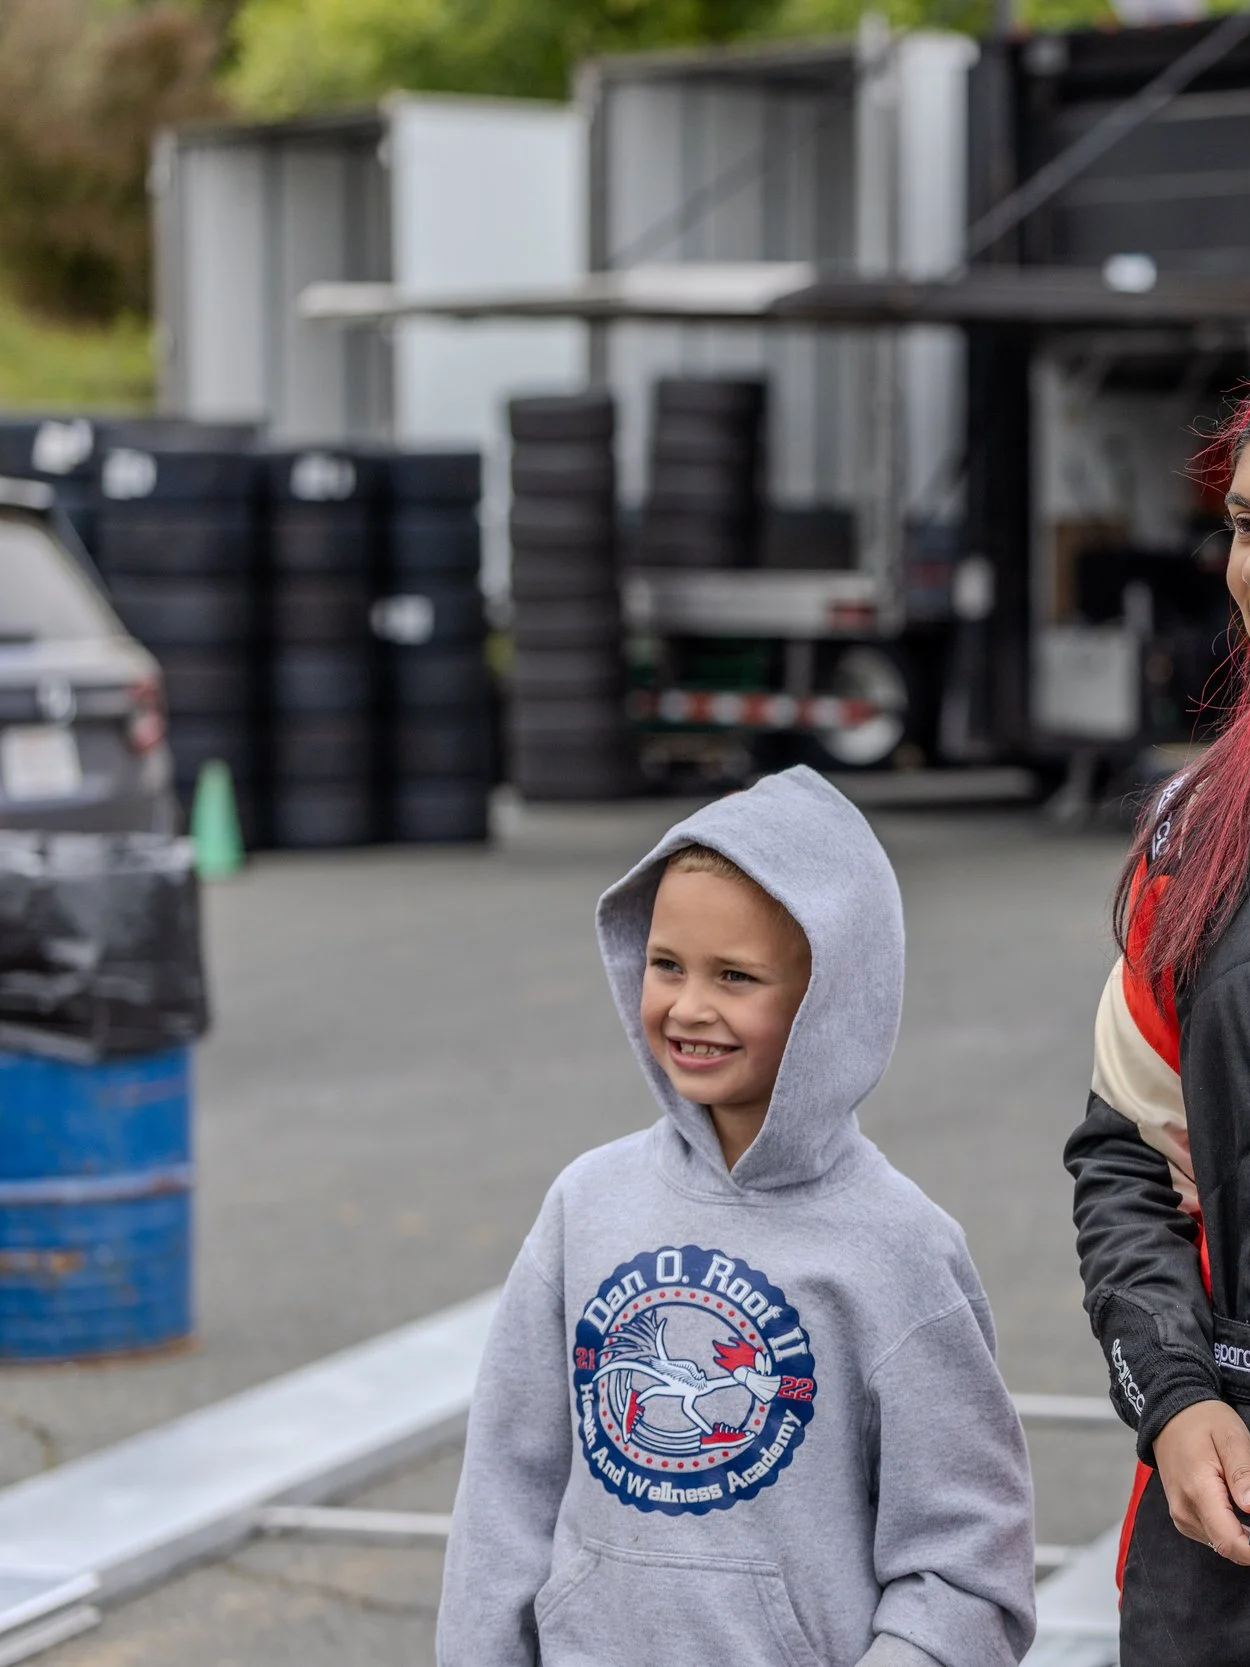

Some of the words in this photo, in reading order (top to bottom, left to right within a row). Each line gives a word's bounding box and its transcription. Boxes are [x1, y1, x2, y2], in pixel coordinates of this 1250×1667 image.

[584, 1270, 647, 1335] Dan
[656, 1250, 690, 1284] O.
[701, 1254, 782, 1329] Root
[768, 1327, 808, 1362] II
[575, 1347, 596, 1369] 21
[778, 1375, 814, 1401] 22
[580, 1383, 597, 1450] Health
[592, 1446, 626, 1487] And
[627, 1468, 722, 1504] Wellness
[727, 1409, 802, 1493] Academy
